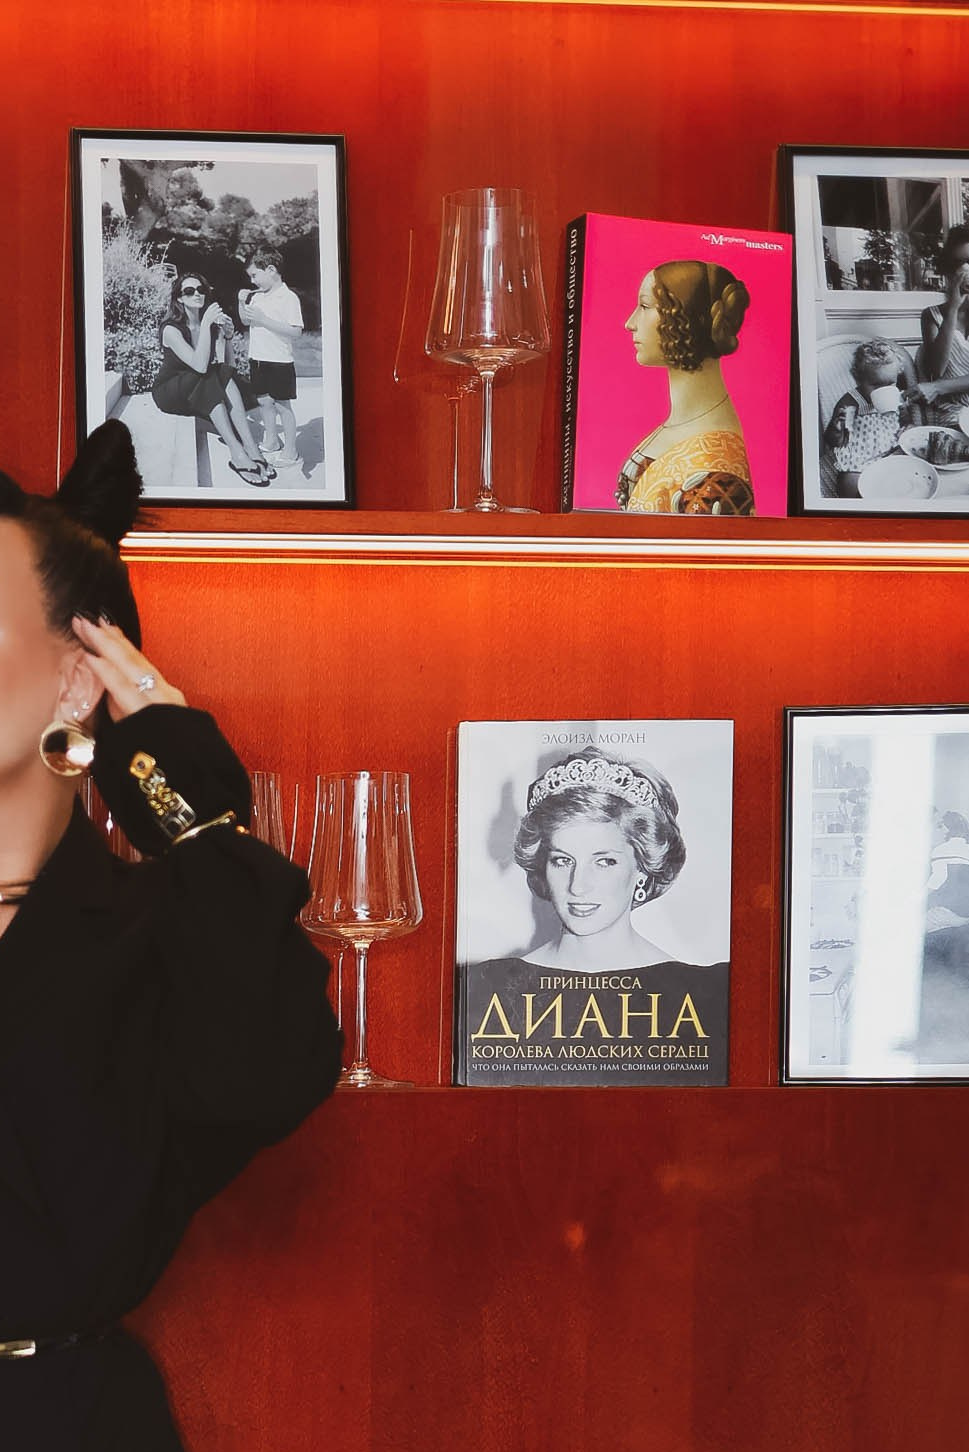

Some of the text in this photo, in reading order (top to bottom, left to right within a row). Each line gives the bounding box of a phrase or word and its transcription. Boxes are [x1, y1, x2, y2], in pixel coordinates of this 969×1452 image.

[745, 240, 784, 251] masters
[566, 228, 578, 309] общество
[568, 313, 575, 324] и
[565, 328, 574, 413] искусство
[542, 732, 646, 744] ЭЛОИЗА МОРАН
[539, 976, 643, 990] ПРИНЦЕССА
[470, 992, 711, 1043] ДИАНА
[471, 1045, 710, 1059] КОРОЛЕВА ЛЮДСКИХ СЕРДЕЦ
[471, 1063, 709, 1071] ЧТО ОНА ПЫТАЛАСЬ СКАЗАТЬ НАМ СВОИМИ ОБРАЗАМИ
